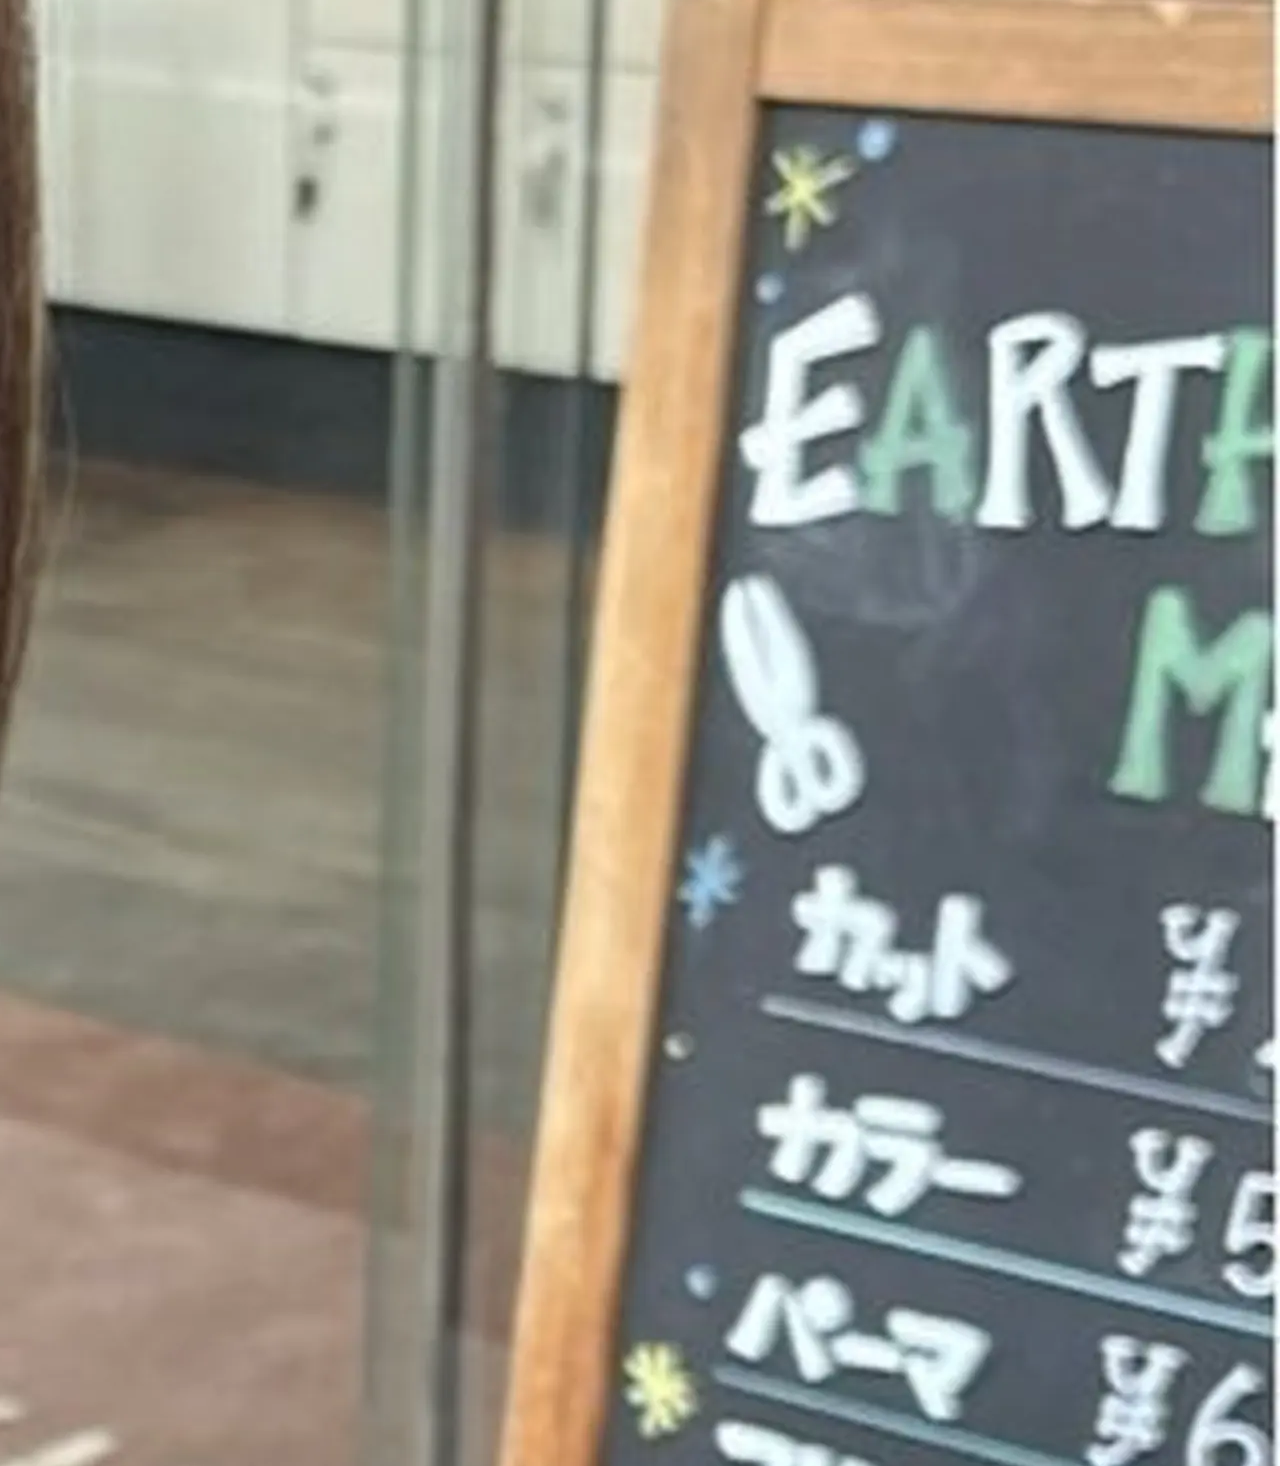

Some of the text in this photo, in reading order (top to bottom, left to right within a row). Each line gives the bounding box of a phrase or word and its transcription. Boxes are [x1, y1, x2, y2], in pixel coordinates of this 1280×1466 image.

[791, 864, 1015, 1023] カット
[757, 1072, 1022, 1216] カラー
[725, 1273, 992, 1420] パーマ
